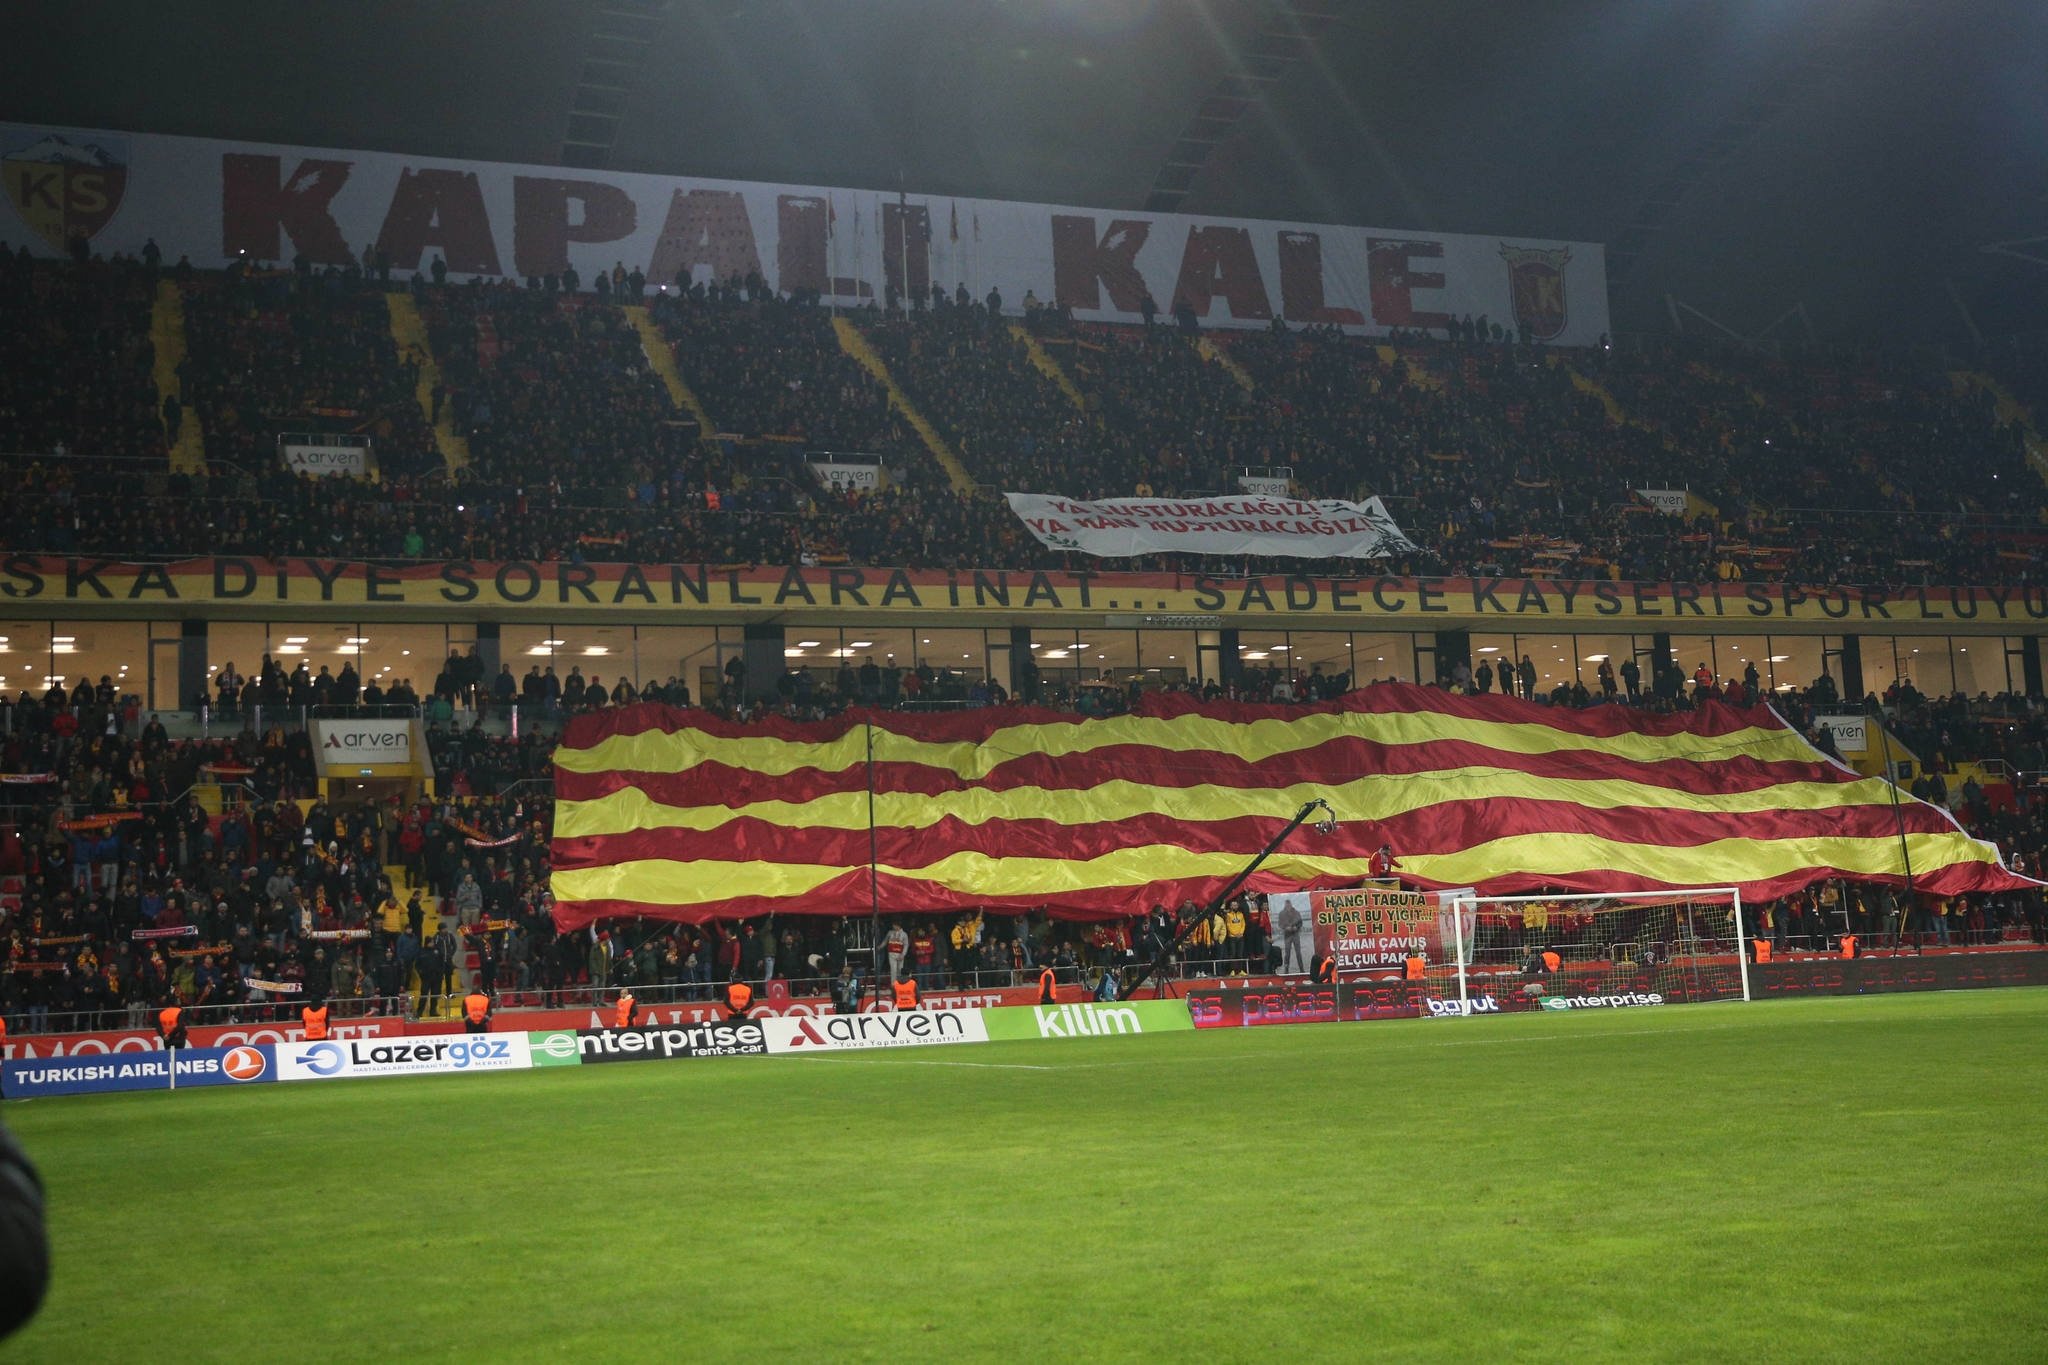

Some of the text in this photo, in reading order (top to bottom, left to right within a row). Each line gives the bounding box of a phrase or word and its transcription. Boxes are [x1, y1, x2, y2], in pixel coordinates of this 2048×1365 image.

[222, 152, 931, 300] KAPALI
[1051, 214, 1446, 329] KALE
[308, 453, 360, 464] arven
[830, 470, 874, 481] arven
[1249, 482, 1287, 494] arven
[1047, 500, 1091, 514] YA
[1649, 495, 1684, 505] arven
[1026, 518, 1071, 533] YA
[440, 562, 922, 606] SORANLARA
[1193, 575, 1449, 612] SADECE
[1831, 725, 1865, 738] rven
[344, 733, 409, 747] arven
[1372, 893, 1426, 906] TABUTA
[1365, 909, 1382, 922] BU
[1336, 954, 1378, 968] ELÇUK
[1549, 991, 1663, 1009] enterprise
[827, 1012, 964, 1041] arven
[1033, 1003, 1143, 1038] kilim
[544, 1021, 762, 1057] enterprise
[350, 1036, 511, 1068] Lazergöz
[691, 1044, 764, 1057] rent-a-car
[15, 1065, 115, 1084] TURKISH
